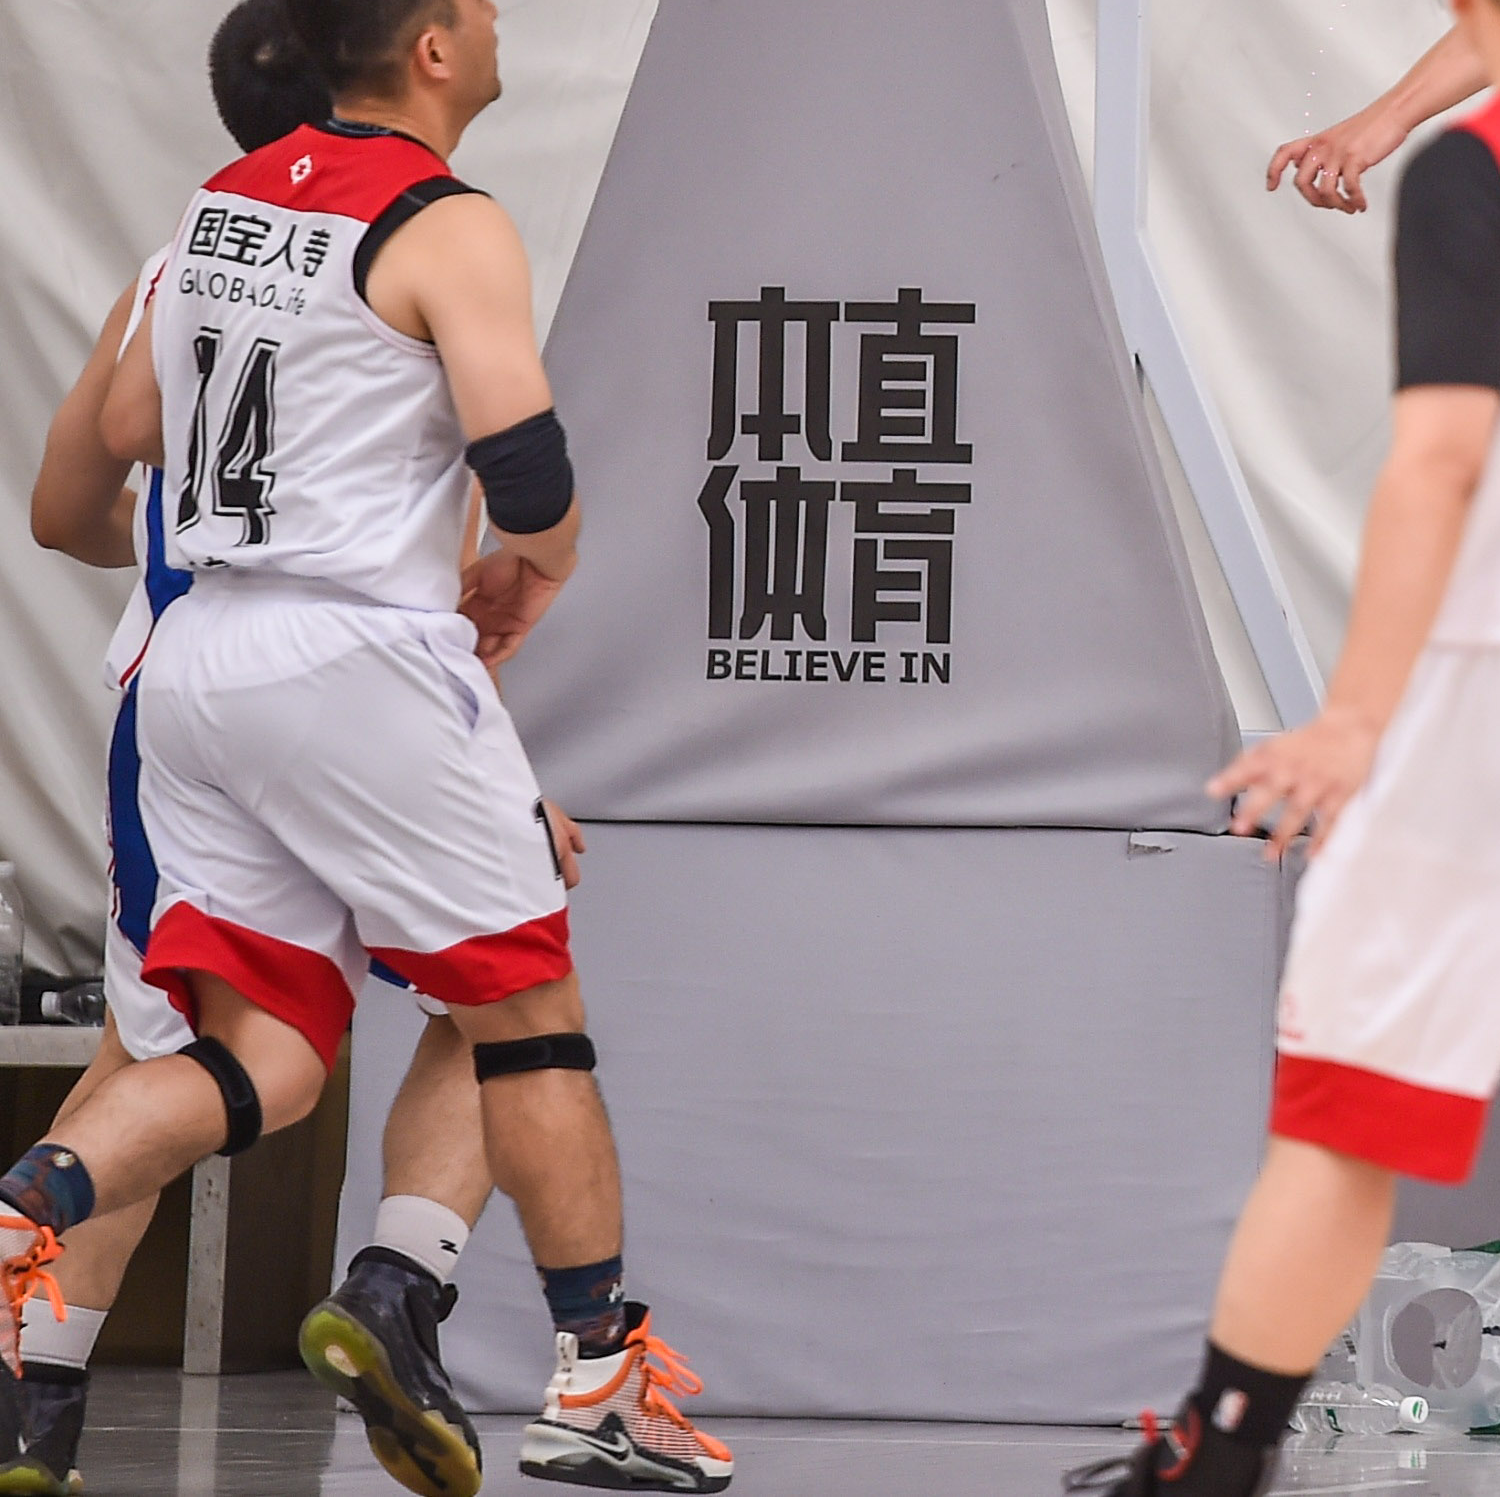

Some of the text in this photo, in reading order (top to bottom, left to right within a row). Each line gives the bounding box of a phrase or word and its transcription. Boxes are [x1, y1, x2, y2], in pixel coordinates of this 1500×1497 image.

[188, 206, 331, 278] 国宝人寿
[176, 326, 279, 547] 14
[698, 465, 972, 644] 体育
[706, 648, 951, 684] BELIEVE IN
